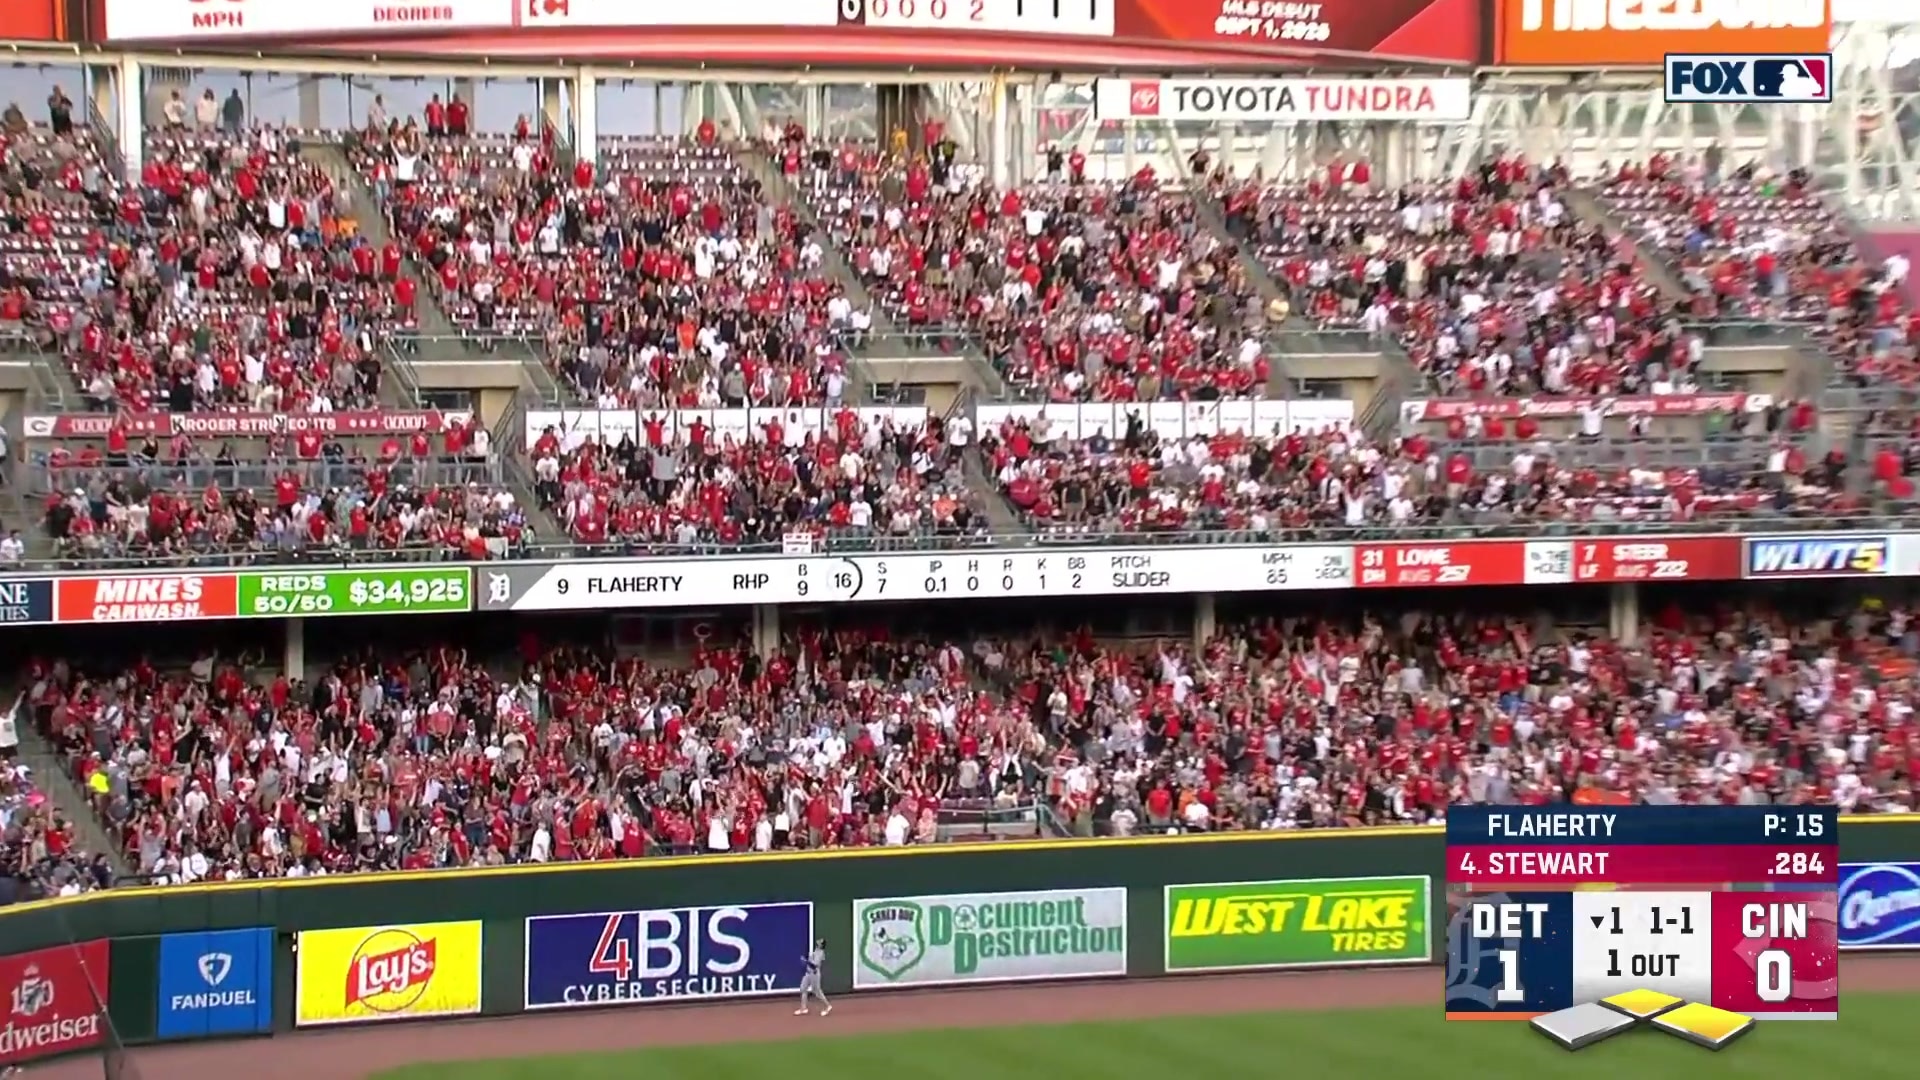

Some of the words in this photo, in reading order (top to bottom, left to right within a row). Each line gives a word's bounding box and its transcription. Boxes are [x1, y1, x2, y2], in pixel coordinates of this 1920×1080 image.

[192, 12, 243, 28] MPH
[373, 6, 453, 22] DEGREES
[1173, 86, 1296, 112] TOYOTA
[1305, 86, 1436, 112] TUNDRA
[929, 560, 943, 573] IP
[968, 559, 979, 572] H
[1003, 558, 1013, 571] R
[1037, 557, 1047, 570] K
[1067, 557, 1086, 570] BB
[1111, 555, 1151, 569] PITCH
[1361, 550, 1384, 567] 31
[877, 561, 887, 574] S
[261, 576, 327, 593] REDS
[557, 579, 569, 595] 9
[587, 576, 683, 593] FLAHERTY
[733, 574, 769, 590] RHP
[797, 580, 808, 596] 9
[835, 573, 852, 589] 16
[878, 578, 887, 594] 7
[924, 576, 947, 593] 0.1
[967, 575, 979, 591] 0
[1002, 574, 1014, 591] 0
[1039, 574, 1046, 590] 1
[1071, 573, 1082, 589] 2
[1112, 571, 1170, 588] SLIDER
[349, 578, 464, 603] $34,925
[254, 594, 333, 613] 50/50
[1171, 898, 1294, 937] WEST
[1301, 894, 1413, 932] LAKE
[589, 907, 751, 981] 4BIS
[954, 924, 1123, 974] Destruction
[1331, 931, 1406, 952] TIRES
[358, 945, 429, 999] Lay's
[563, 982, 643, 1004] CYBER
[655, 973, 777, 997] SECURITY
[172, 990, 256, 1010] FANDUEL
